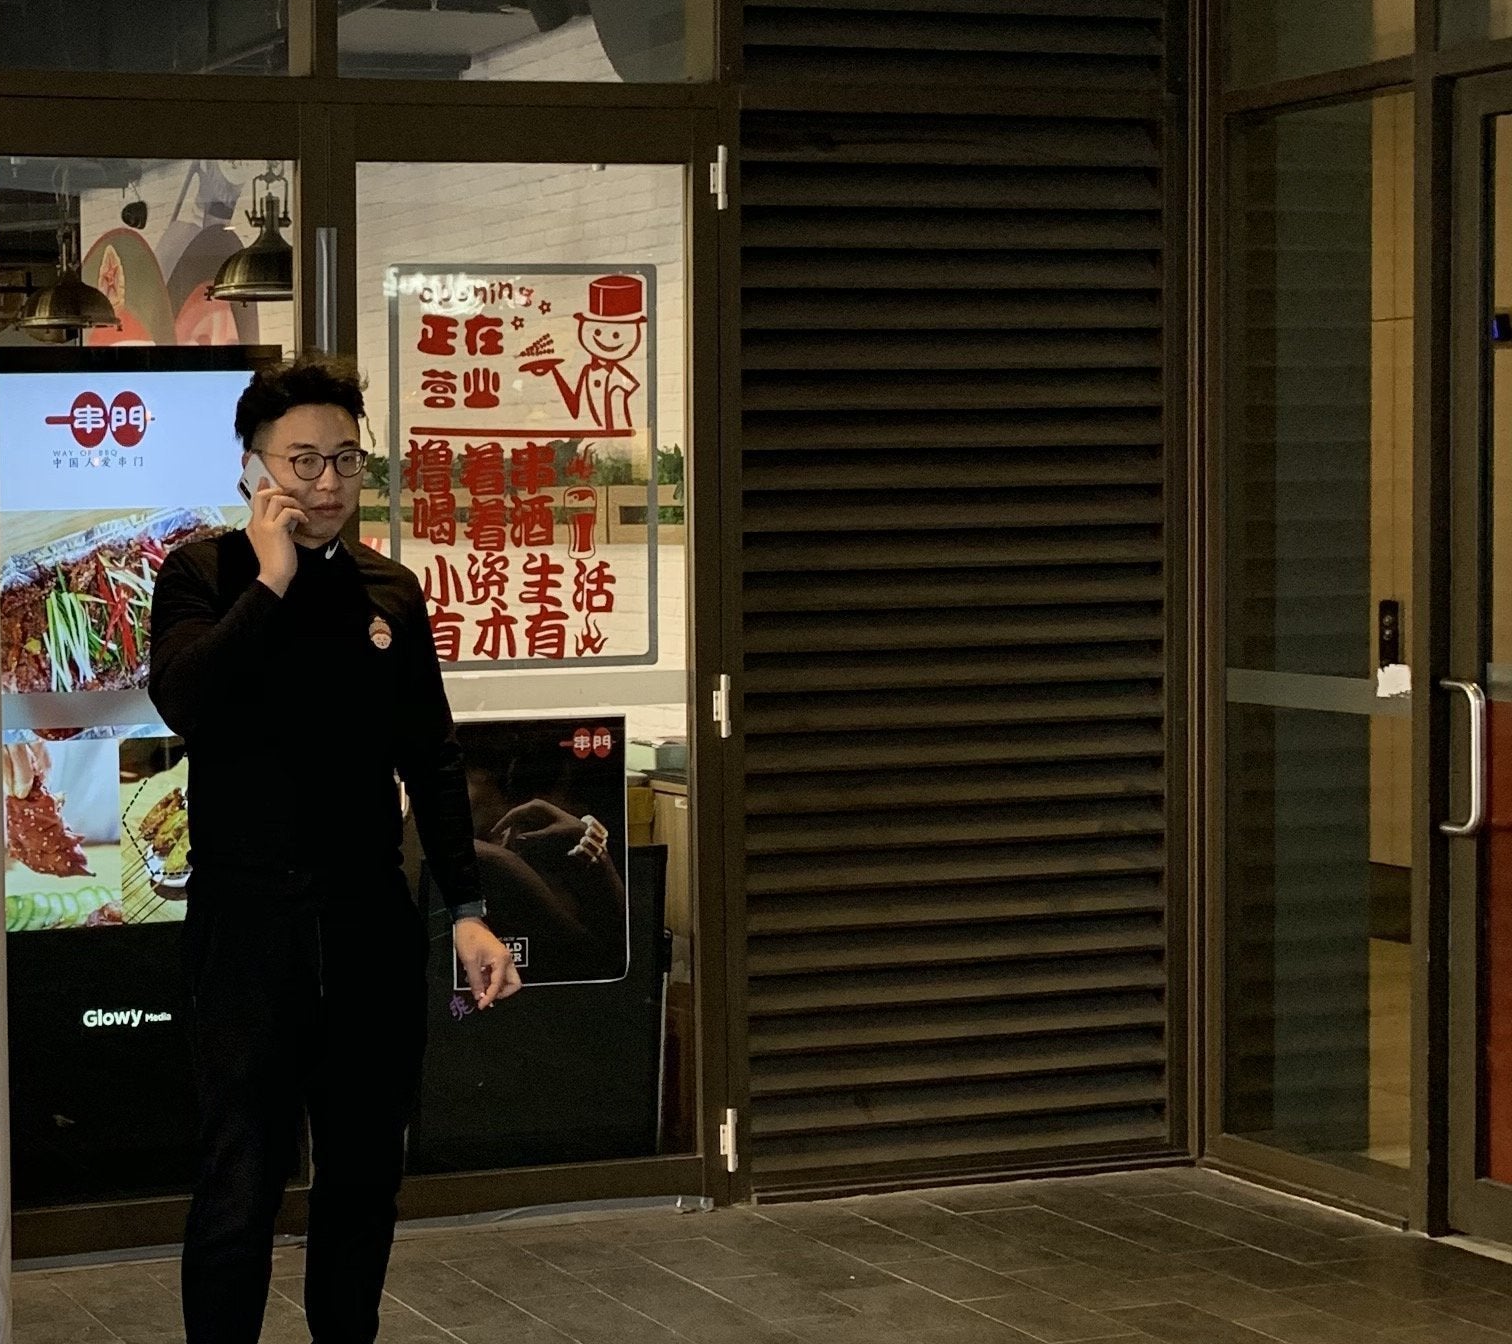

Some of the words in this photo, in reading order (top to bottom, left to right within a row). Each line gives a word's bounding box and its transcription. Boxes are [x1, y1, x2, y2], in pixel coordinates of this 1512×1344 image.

[417, 314, 504, 357] 正在
[421, 367, 501, 409] 营业
[52, 449, 74, 457] WAY
[404, 439, 557, 496] 撸着串
[412, 493, 555, 553] 喝着酒
[424, 552, 617, 614] 小资生活
[82, 1008, 144, 1028] Glowy
